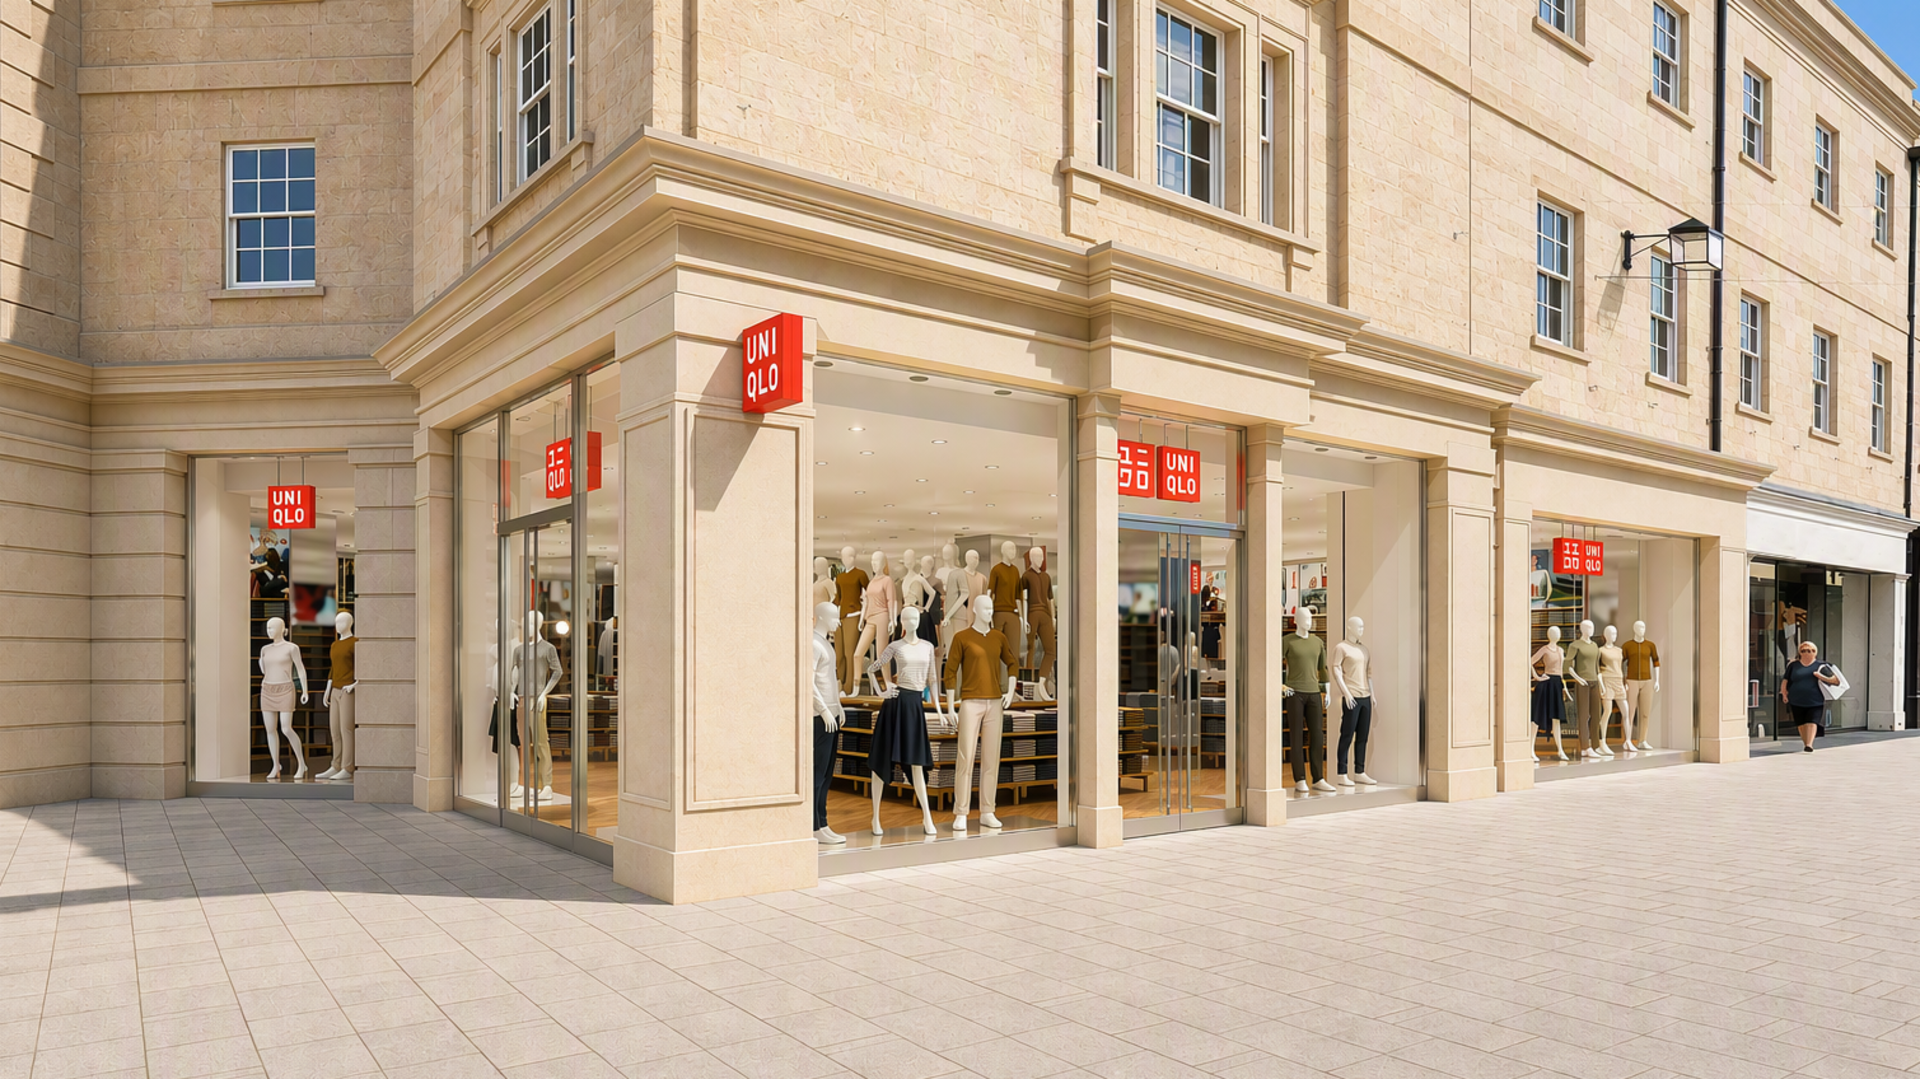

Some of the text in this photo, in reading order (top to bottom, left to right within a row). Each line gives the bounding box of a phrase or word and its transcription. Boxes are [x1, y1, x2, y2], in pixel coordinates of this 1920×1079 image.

[747, 327, 776, 364] UNI
[747, 363, 778, 403] QLO
[1167, 453, 1193, 473] UNI
[548, 468, 565, 492] QLO
[1167, 475, 1196, 495] QLO
[273, 491, 300, 505] UNI
[274, 508, 304, 525] QLO
[1585, 545, 1601, 558] UNI
[1585, 559, 1601, 572] QLO
